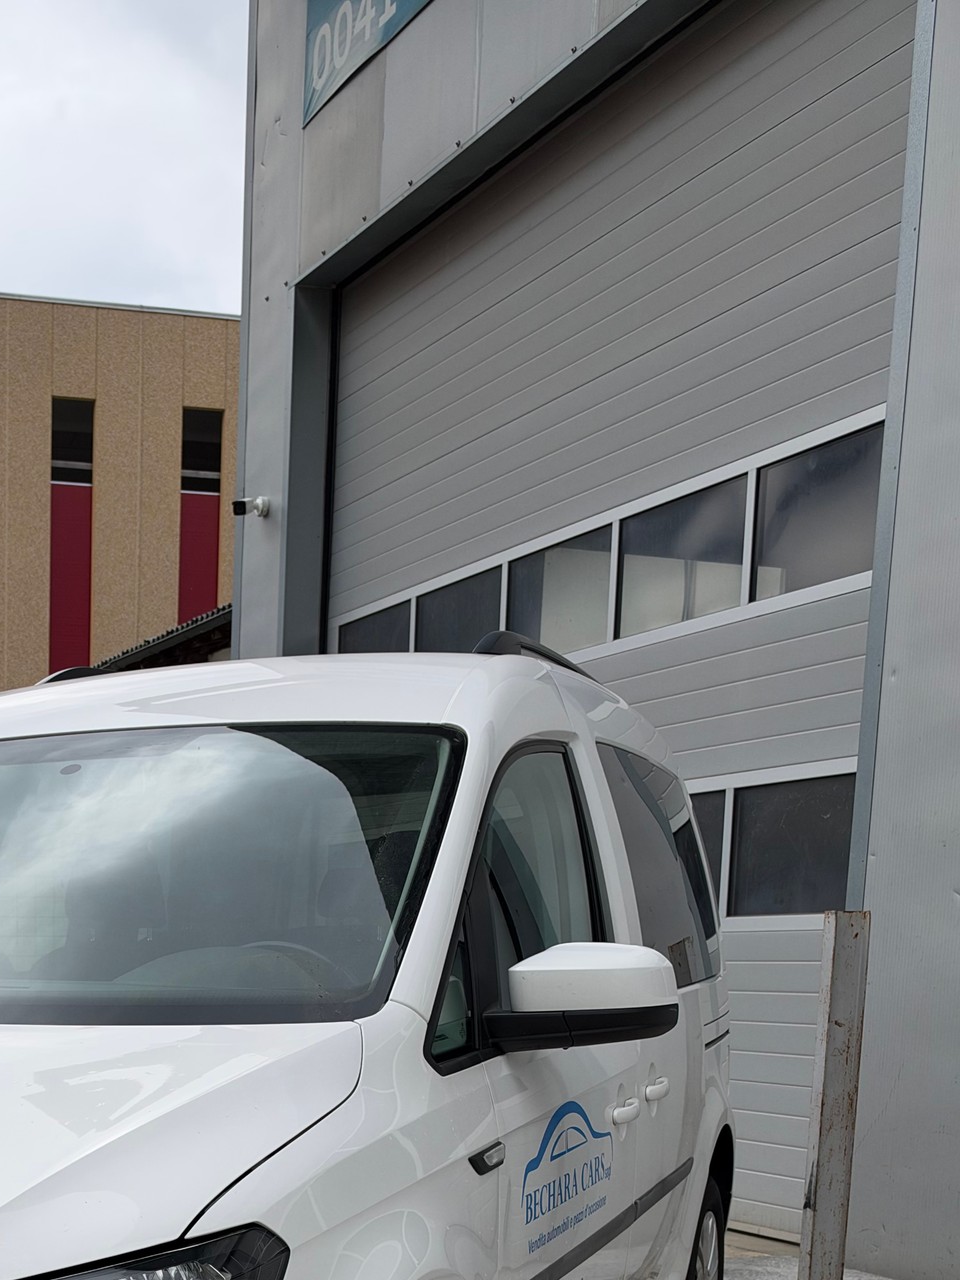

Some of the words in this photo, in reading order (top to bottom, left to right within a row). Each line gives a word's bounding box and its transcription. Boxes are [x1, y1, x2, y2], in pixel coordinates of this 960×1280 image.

[525, 1168, 578, 1226] BECHARA
[581, 1153, 606, 1191] CARS
[528, 1232, 546, 1255] Vendita
